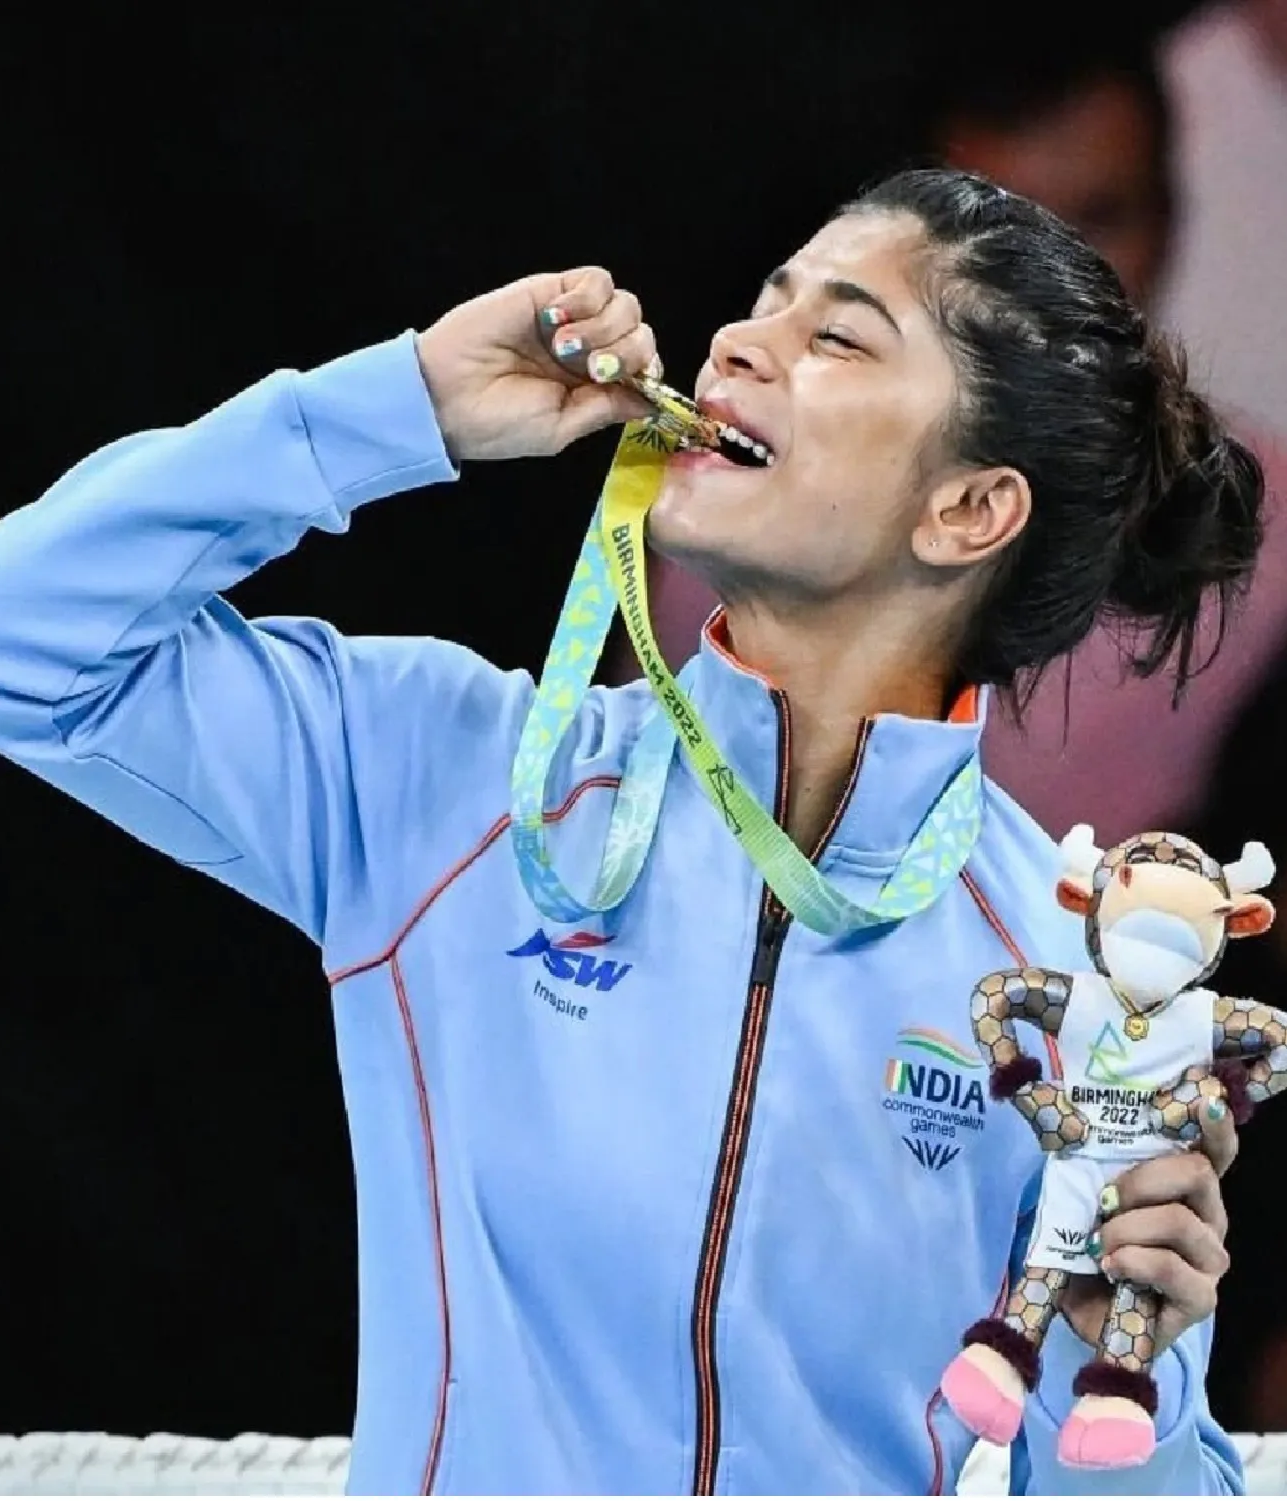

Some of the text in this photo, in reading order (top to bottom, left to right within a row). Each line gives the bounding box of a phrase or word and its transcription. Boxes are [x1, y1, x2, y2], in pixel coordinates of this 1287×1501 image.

[611, 522, 702, 750] BIRMINGHAM 2022
[885, 1058, 986, 1115] INDIA
[882, 1098, 985, 1132] commonwealth
[909, 1118, 957, 1139] games
[1099, 1105, 1140, 1126] 2022
